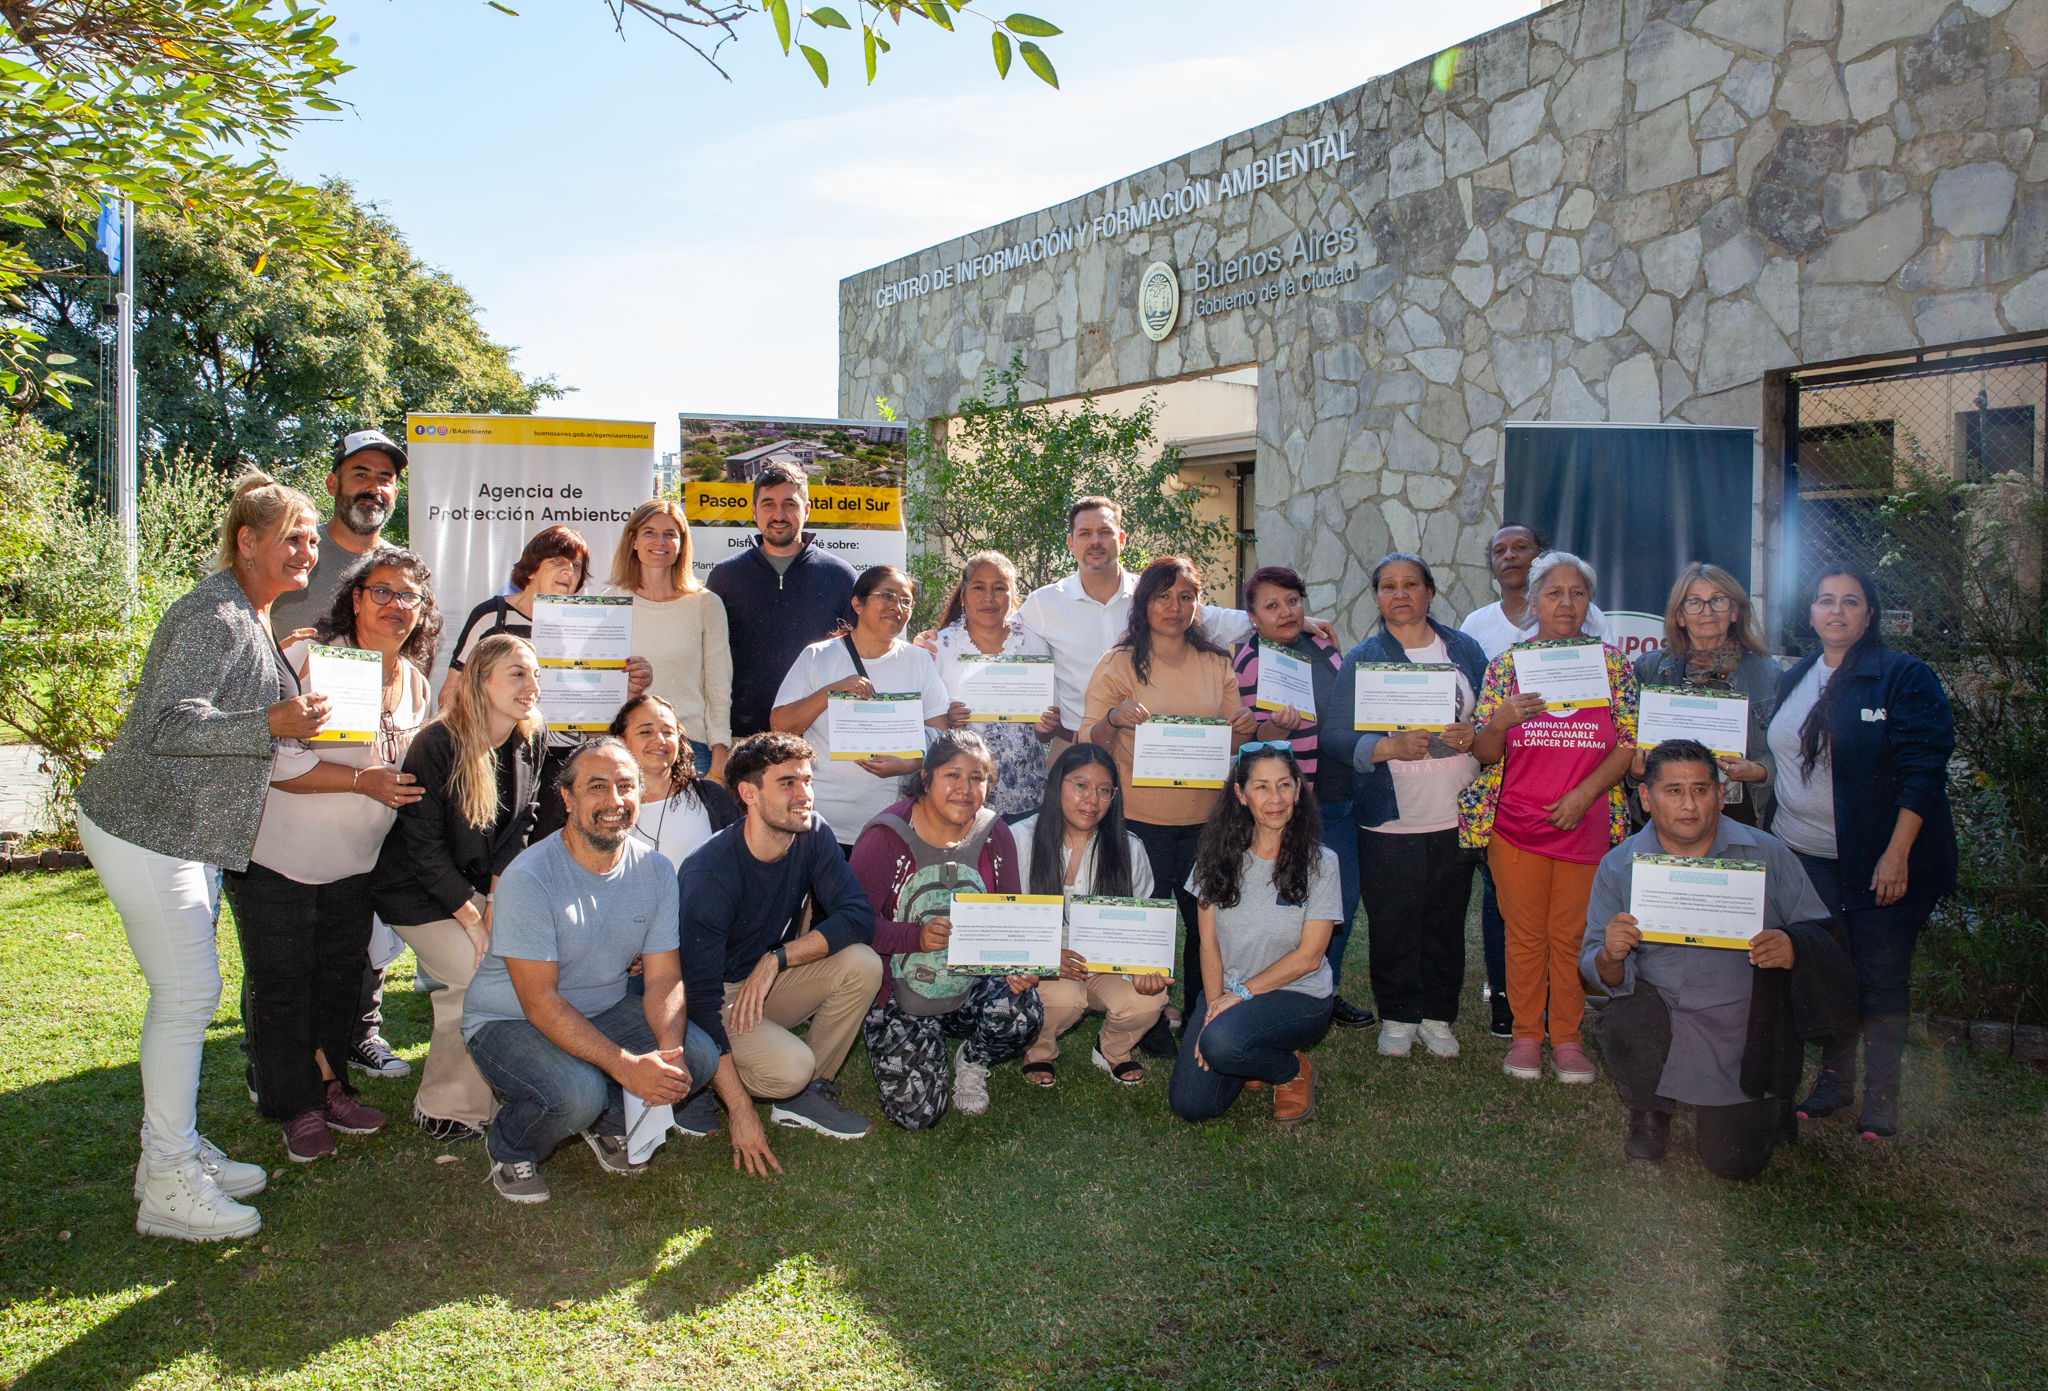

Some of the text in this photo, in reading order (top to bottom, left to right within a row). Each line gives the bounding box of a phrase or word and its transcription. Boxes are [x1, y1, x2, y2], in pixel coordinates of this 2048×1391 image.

[876, 130, 1356, 309] CENTRO DE INFORMACIÓN Y FORMACIÓN AMBIENTAL
[1194, 227, 1357, 292] Buenos Aires
[1194, 261, 1357, 317] Gobierno de la Ciudad
[533, 430, 649, 440] buenosaires.gob.ar/agenciaambiental
[478, 483, 583, 502] Agencia de
[699, 493, 748, 508] Paseo
[837, 498, 861, 511] del
[865, 499, 891, 511] Sur
[428, 506, 636, 522] Protección Ambienta
[827, 540, 859, 550] sobre:
[1521, 721, 1599, 731] CAMINATA AVON
[1524, 730, 1595, 739] PARA GANARLE
[1512, 737, 1606, 750] AL CÁNCER DE MAMA
[1390, 758, 1467, 773] RIHANNA
